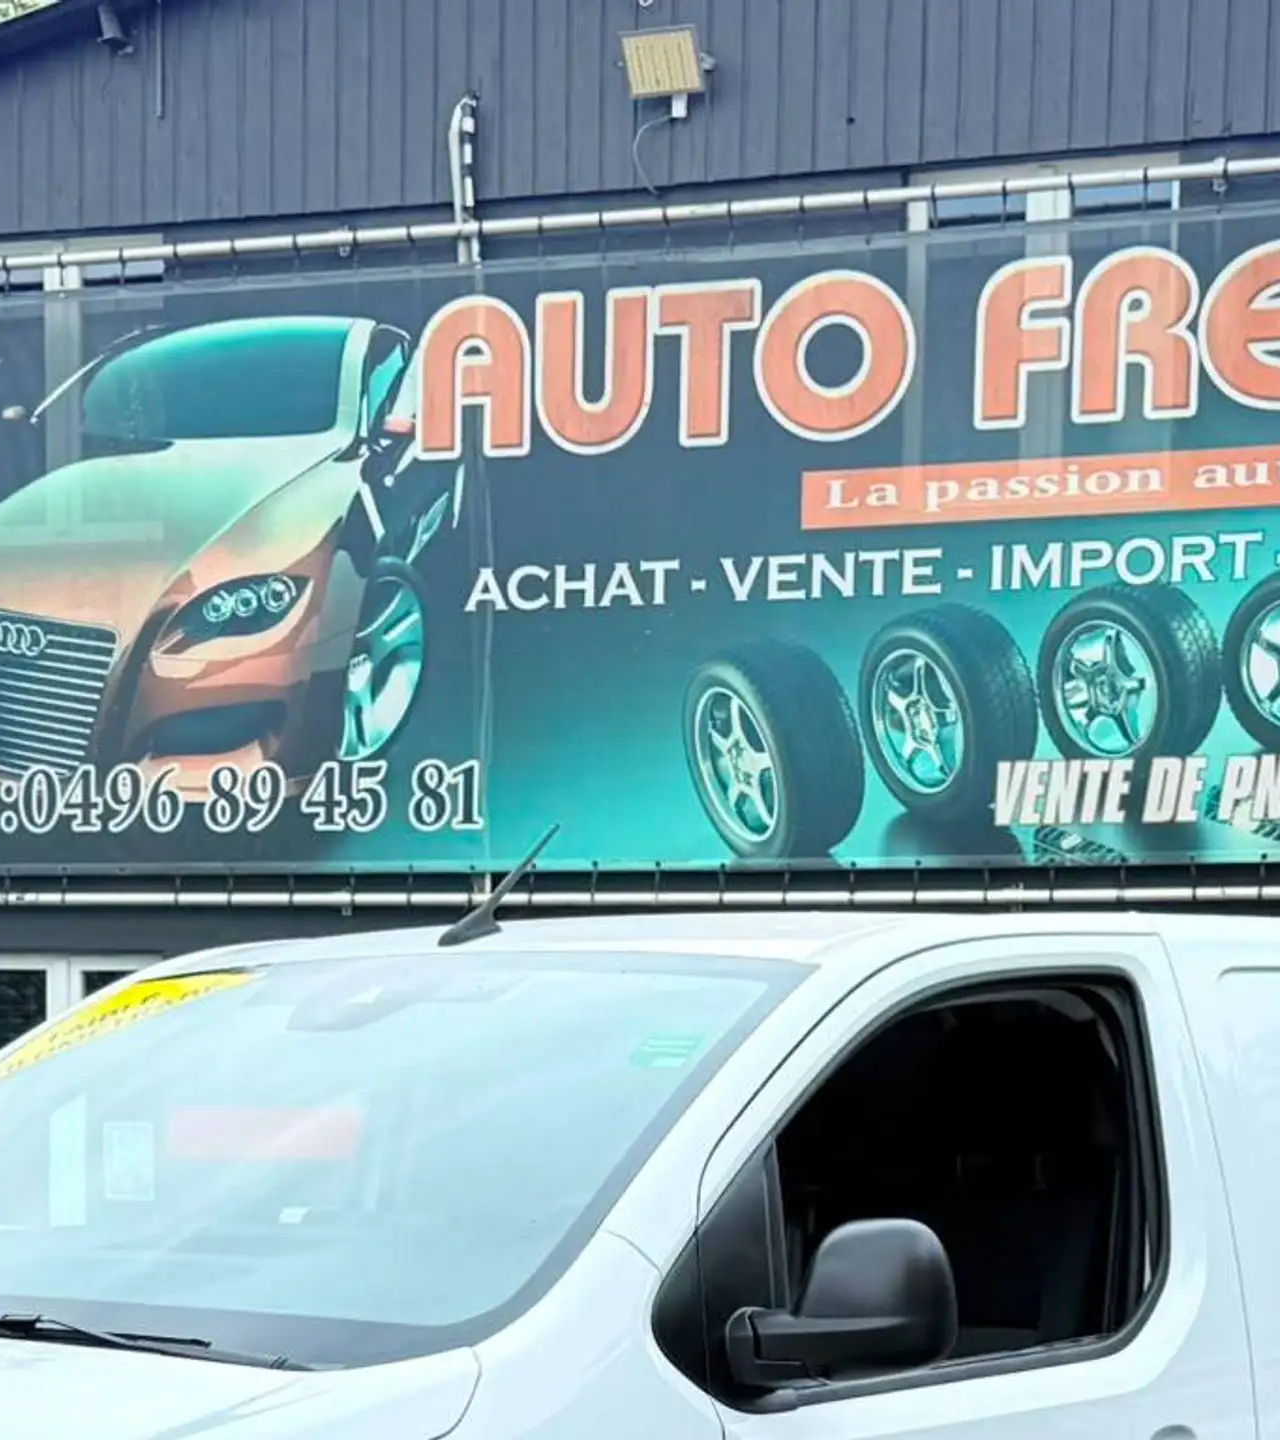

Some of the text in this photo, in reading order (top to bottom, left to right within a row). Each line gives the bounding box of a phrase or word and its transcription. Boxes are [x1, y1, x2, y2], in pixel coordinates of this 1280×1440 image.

[412, 269, 917, 460] AUTO
[825, 478, 900, 510] La
[924, 464, 1164, 513] passion
[463, 559, 680, 613] ACHAT
[720, 547, 942, 602] VENTE
[990, 530, 1265, 591] IMPORT
[203, 761, 286, 832] 89
[300, 760, 388, 832] 45
[408, 758, 484, 831] 81
[994, 758, 1134, 826] VENTE
[1141, 756, 1207, 823] DE
